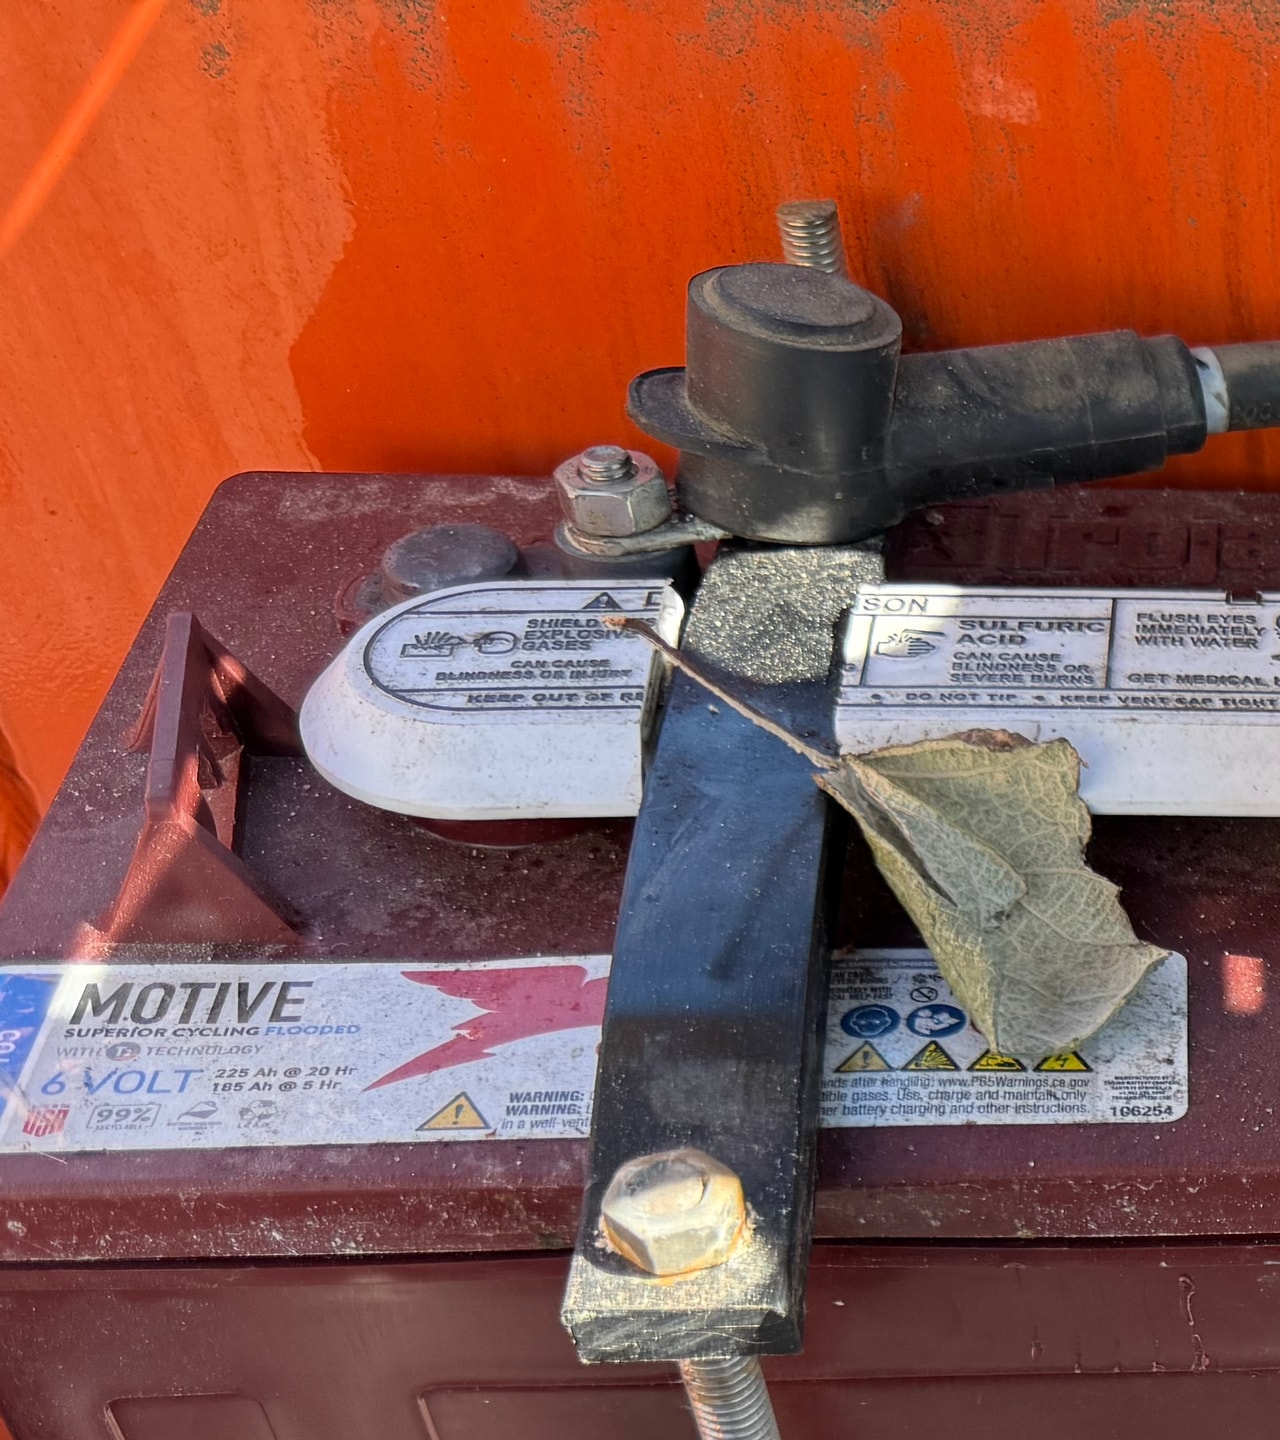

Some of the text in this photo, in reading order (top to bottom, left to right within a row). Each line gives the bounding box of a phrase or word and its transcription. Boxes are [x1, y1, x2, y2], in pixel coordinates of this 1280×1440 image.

[863, 598, 929, 613] SON
[527, 618, 598, 629] SHIELD
[1136, 613, 1257, 625] FLUSH EYES
[959, 620, 1105, 633] SULFURIC
[1135, 624, 1267, 636] IMMEDIATELY
[521, 640, 591, 651] GASES
[957, 634, 1027, 646] ACID
[1135, 636, 1259, 649] WITH WATER
[953, 652, 1062, 663] CAN CAUSE
[511, 659, 610, 669] CAN CAUSE
[952, 663, 1090, 673] BLINDNESS OR
[435, 669, 633, 681] BLINDNESS OR INJURY
[950, 673, 1095, 684] SEVERE BURNS
[1127, 673, 1168, 684] GET
[1176, 674, 1261, 687] MEDICAL
[467, 693, 613, 703] KEEP OUT OF
[906, 693, 1018, 701] DO NOT TIP
[1060, 694, 1110, 703] KEEP
[1118, 696, 1167, 706] VENT
[1174, 697, 1213, 707] CAP
[1219, 697, 1277, 708] TIGHT
[69, 981, 314, 1025] MOTIVE
[64, 1025, 361, 1038] SUPERIOR CYCLING FLOODED
[57, 1045, 264, 1057] WITH TECHNOLOGY
[214, 1065, 358, 1079] 225 Ah @ 20 Hr
[41, 1069, 204, 1095] 6 VOLT
[212, 1079, 341, 1092] 185 Ah @ 5 Hr
[851, 1077, 878, 1088] after
[509, 1090, 585, 1103] WARNING:
[851, 1091, 893, 1104] gases.
[928, 1089, 971, 1104] charge
[975, 1089, 999, 1101] and
[1061, 1090, 1087, 1103] only
[97, 1107, 152, 1123] 99%
[505, 1103, 582, 1116] WARNING:
[842, 1104, 887, 1118] battery
[890, 1103, 946, 1117] charging
[950, 1102, 974, 1115] and
[977, 1103, 1011, 1115] other
[501, 1118, 513, 1129] in
